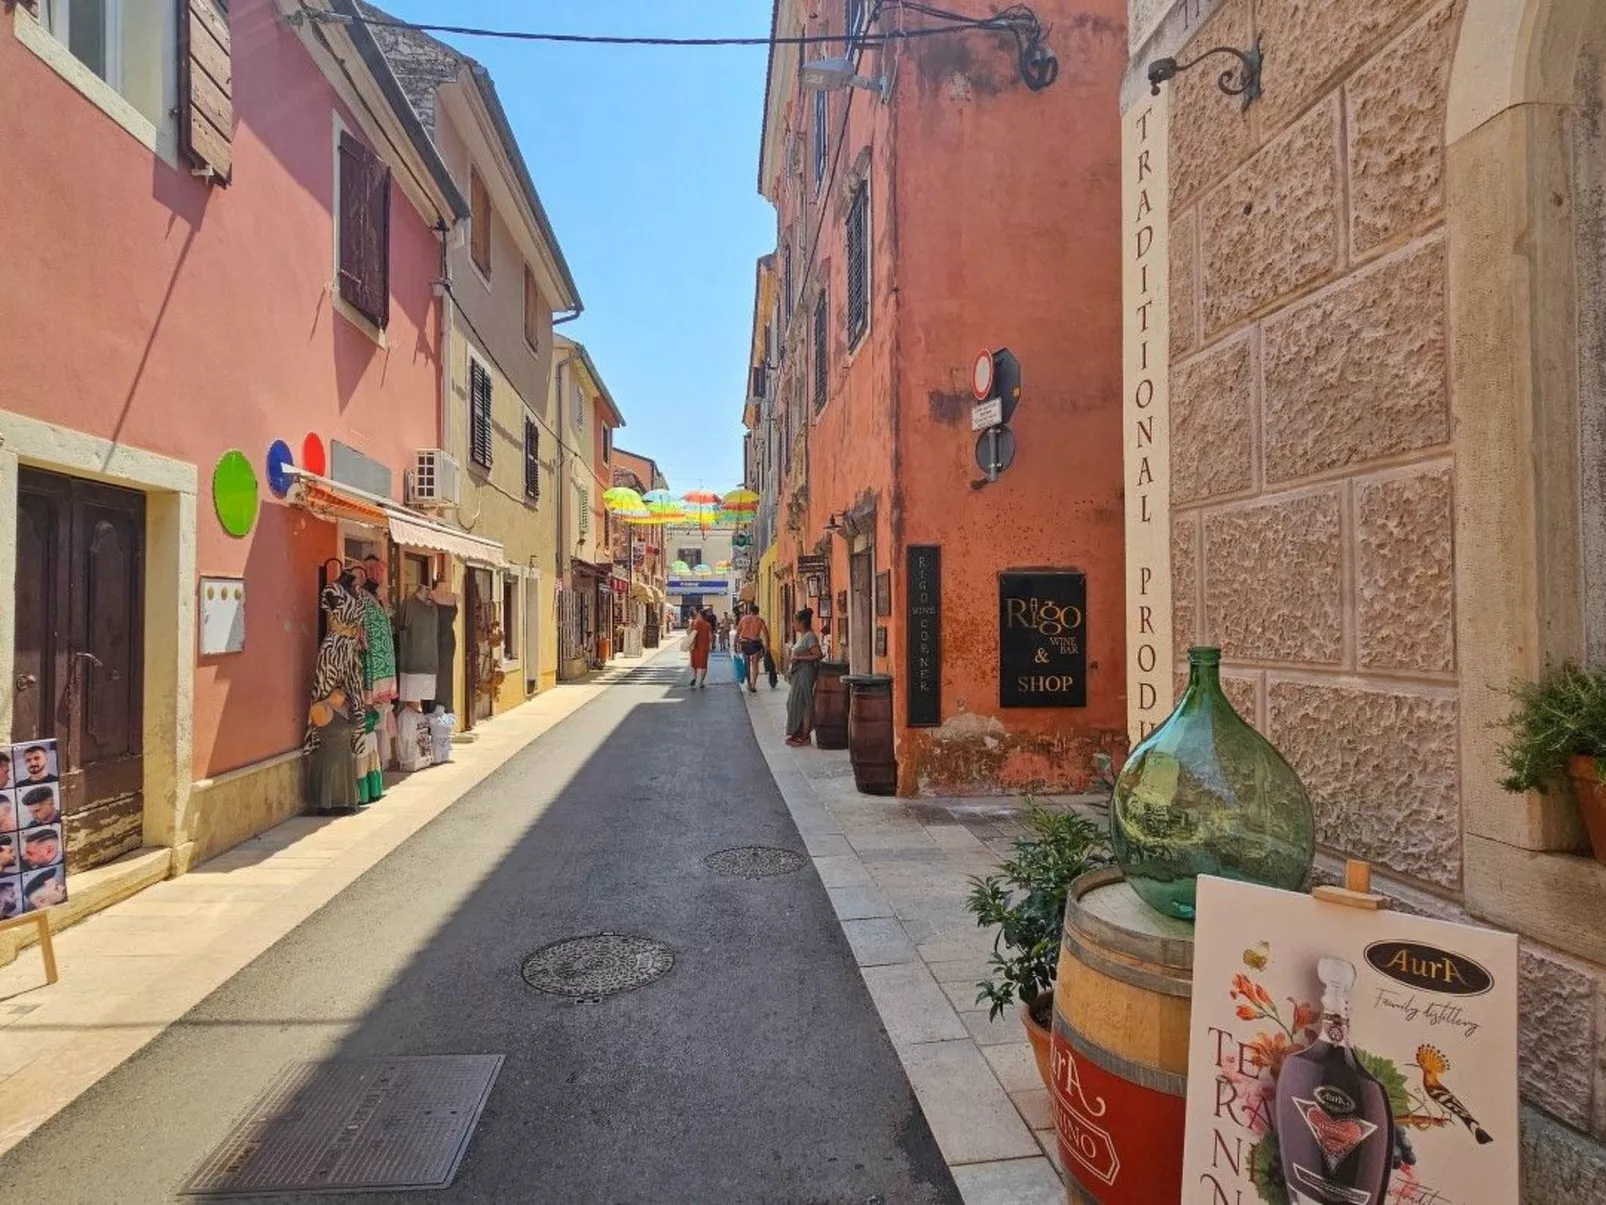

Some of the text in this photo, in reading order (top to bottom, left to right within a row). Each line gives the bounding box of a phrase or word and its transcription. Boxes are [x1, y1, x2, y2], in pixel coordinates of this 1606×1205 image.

[1135, 107, 1154, 524] TRADITIONAL
[1049, 636, 1077, 647] WINE
[1059, 645, 1079, 655] BAR
[1034, 647, 1050, 664] &
[1017, 675, 1074, 693] SHOP
